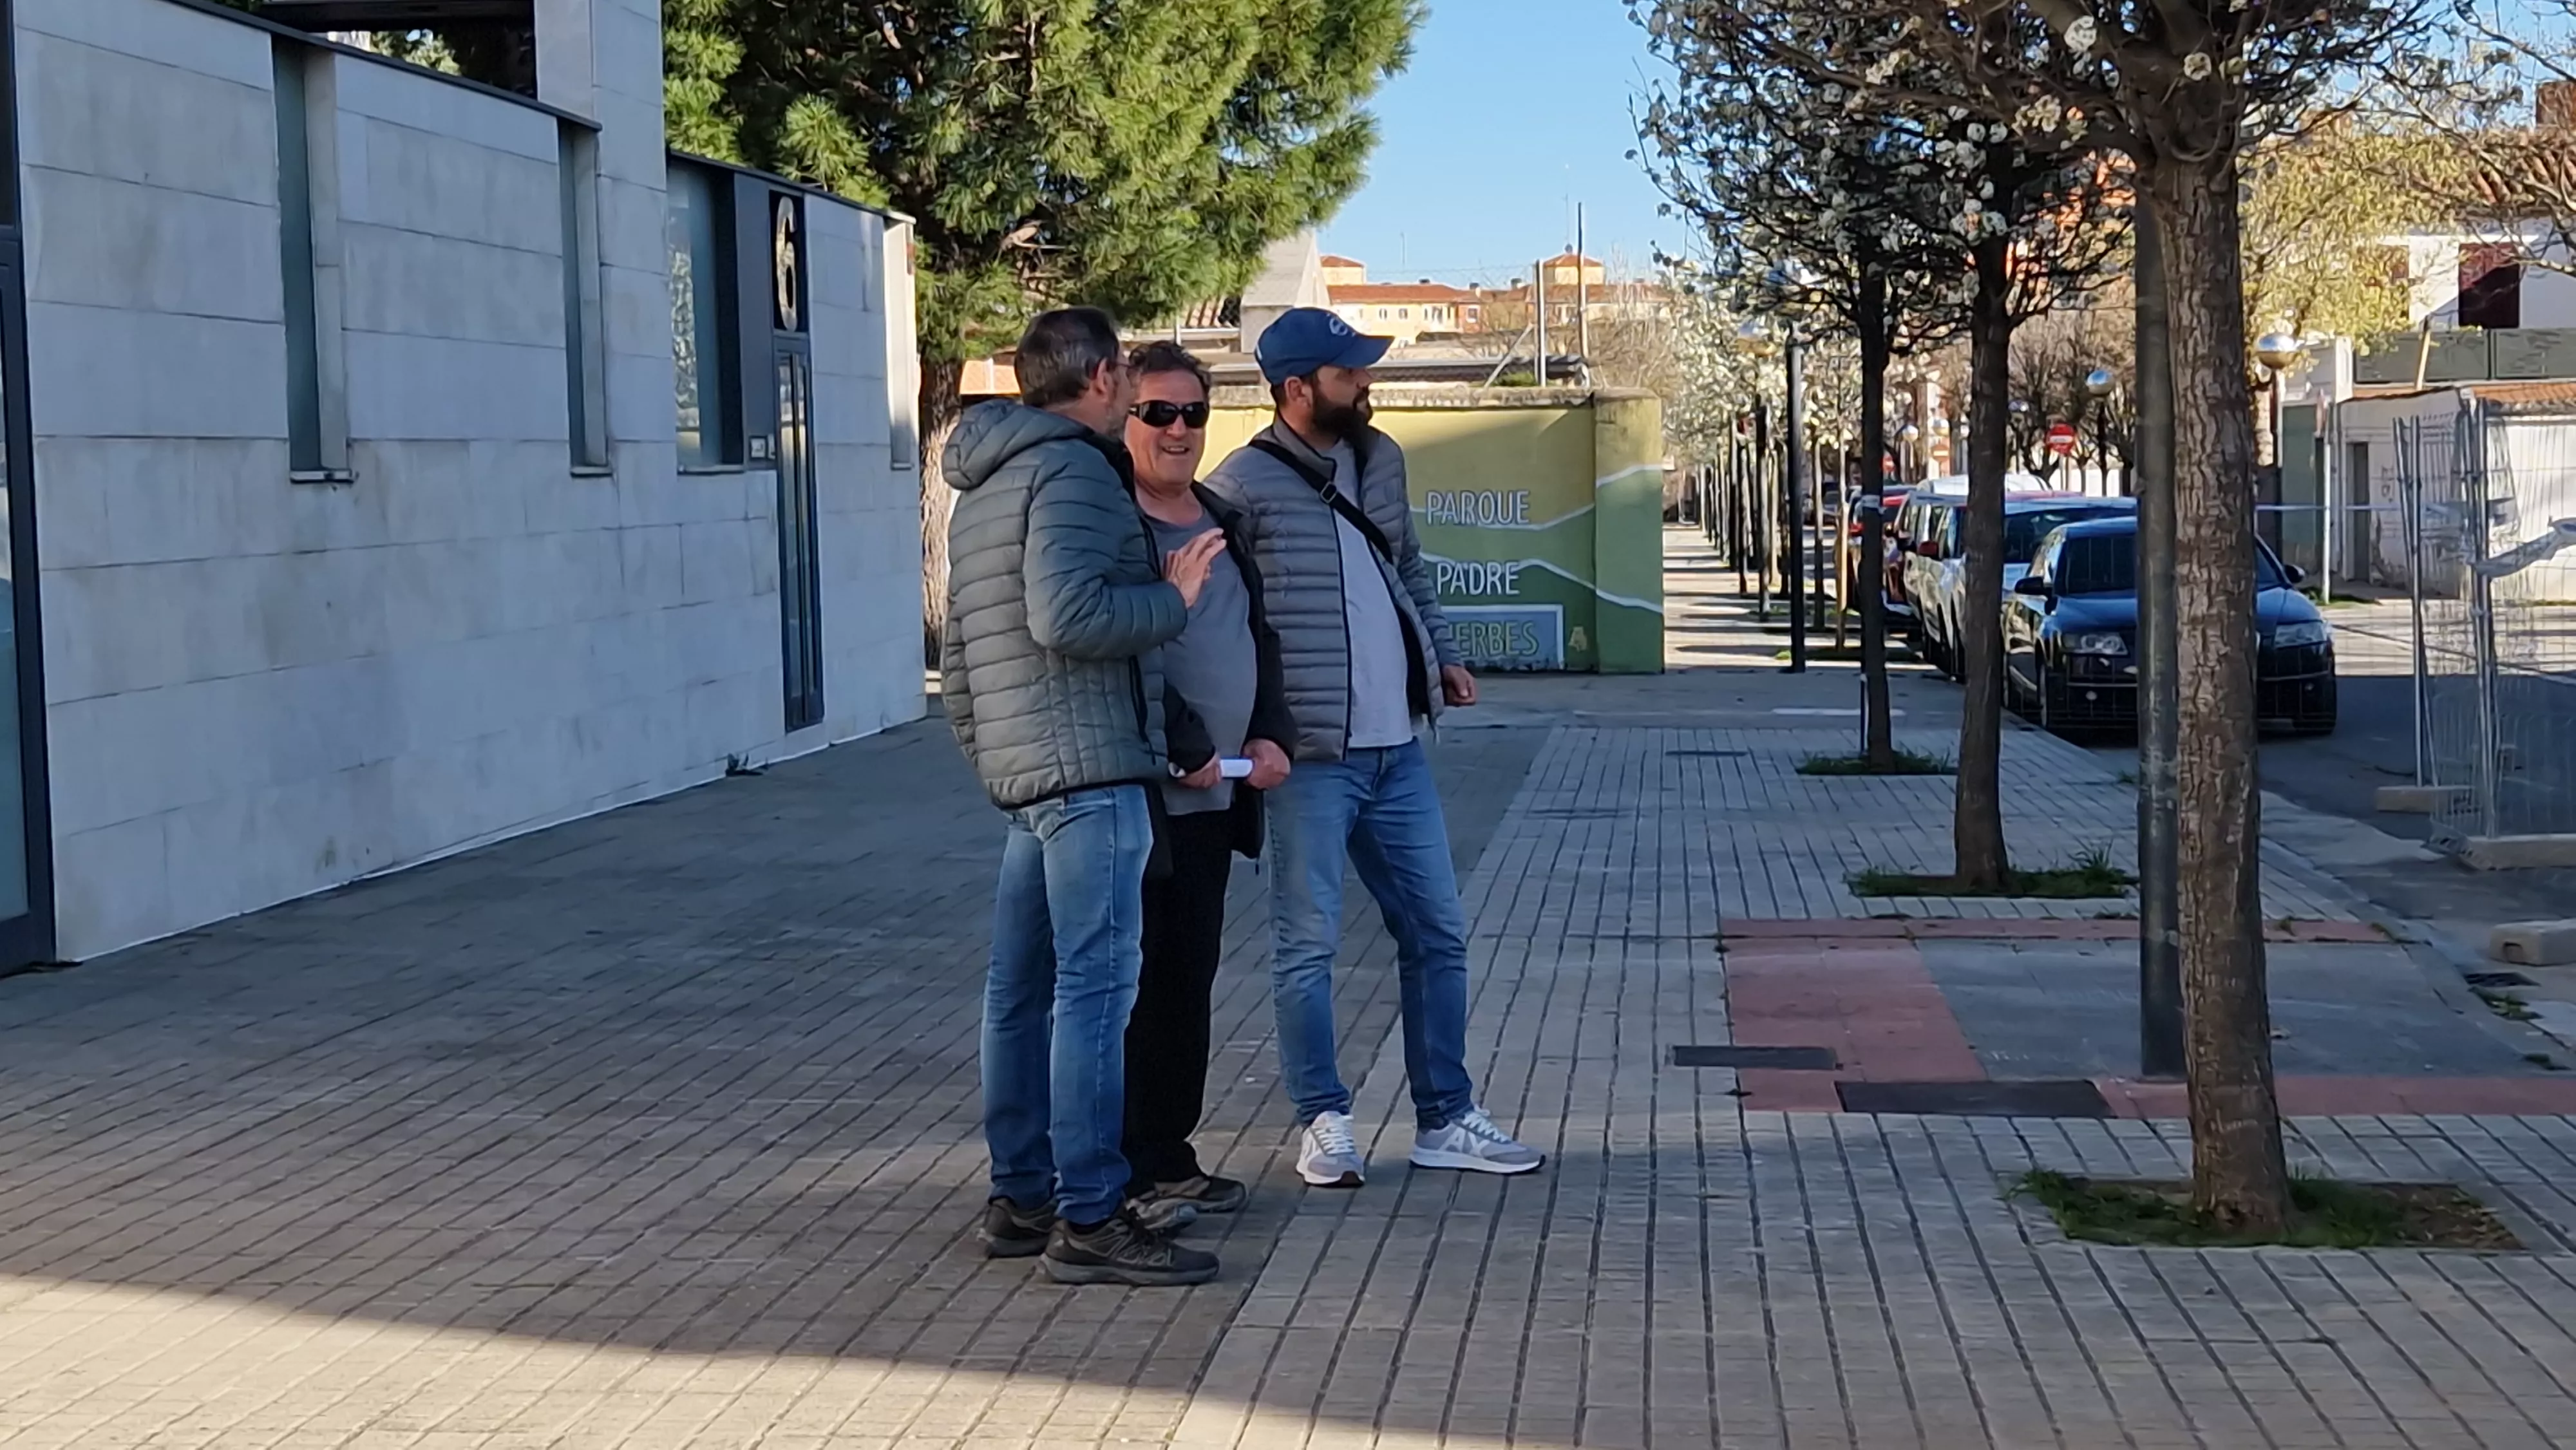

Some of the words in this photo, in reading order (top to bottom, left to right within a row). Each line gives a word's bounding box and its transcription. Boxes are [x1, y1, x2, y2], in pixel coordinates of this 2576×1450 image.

[776, 196, 797, 332] 6
[1426, 490, 1530, 525] PARQUE
[1437, 561, 1520, 596] PADRE
[1448, 621, 1539, 657] ERBES
